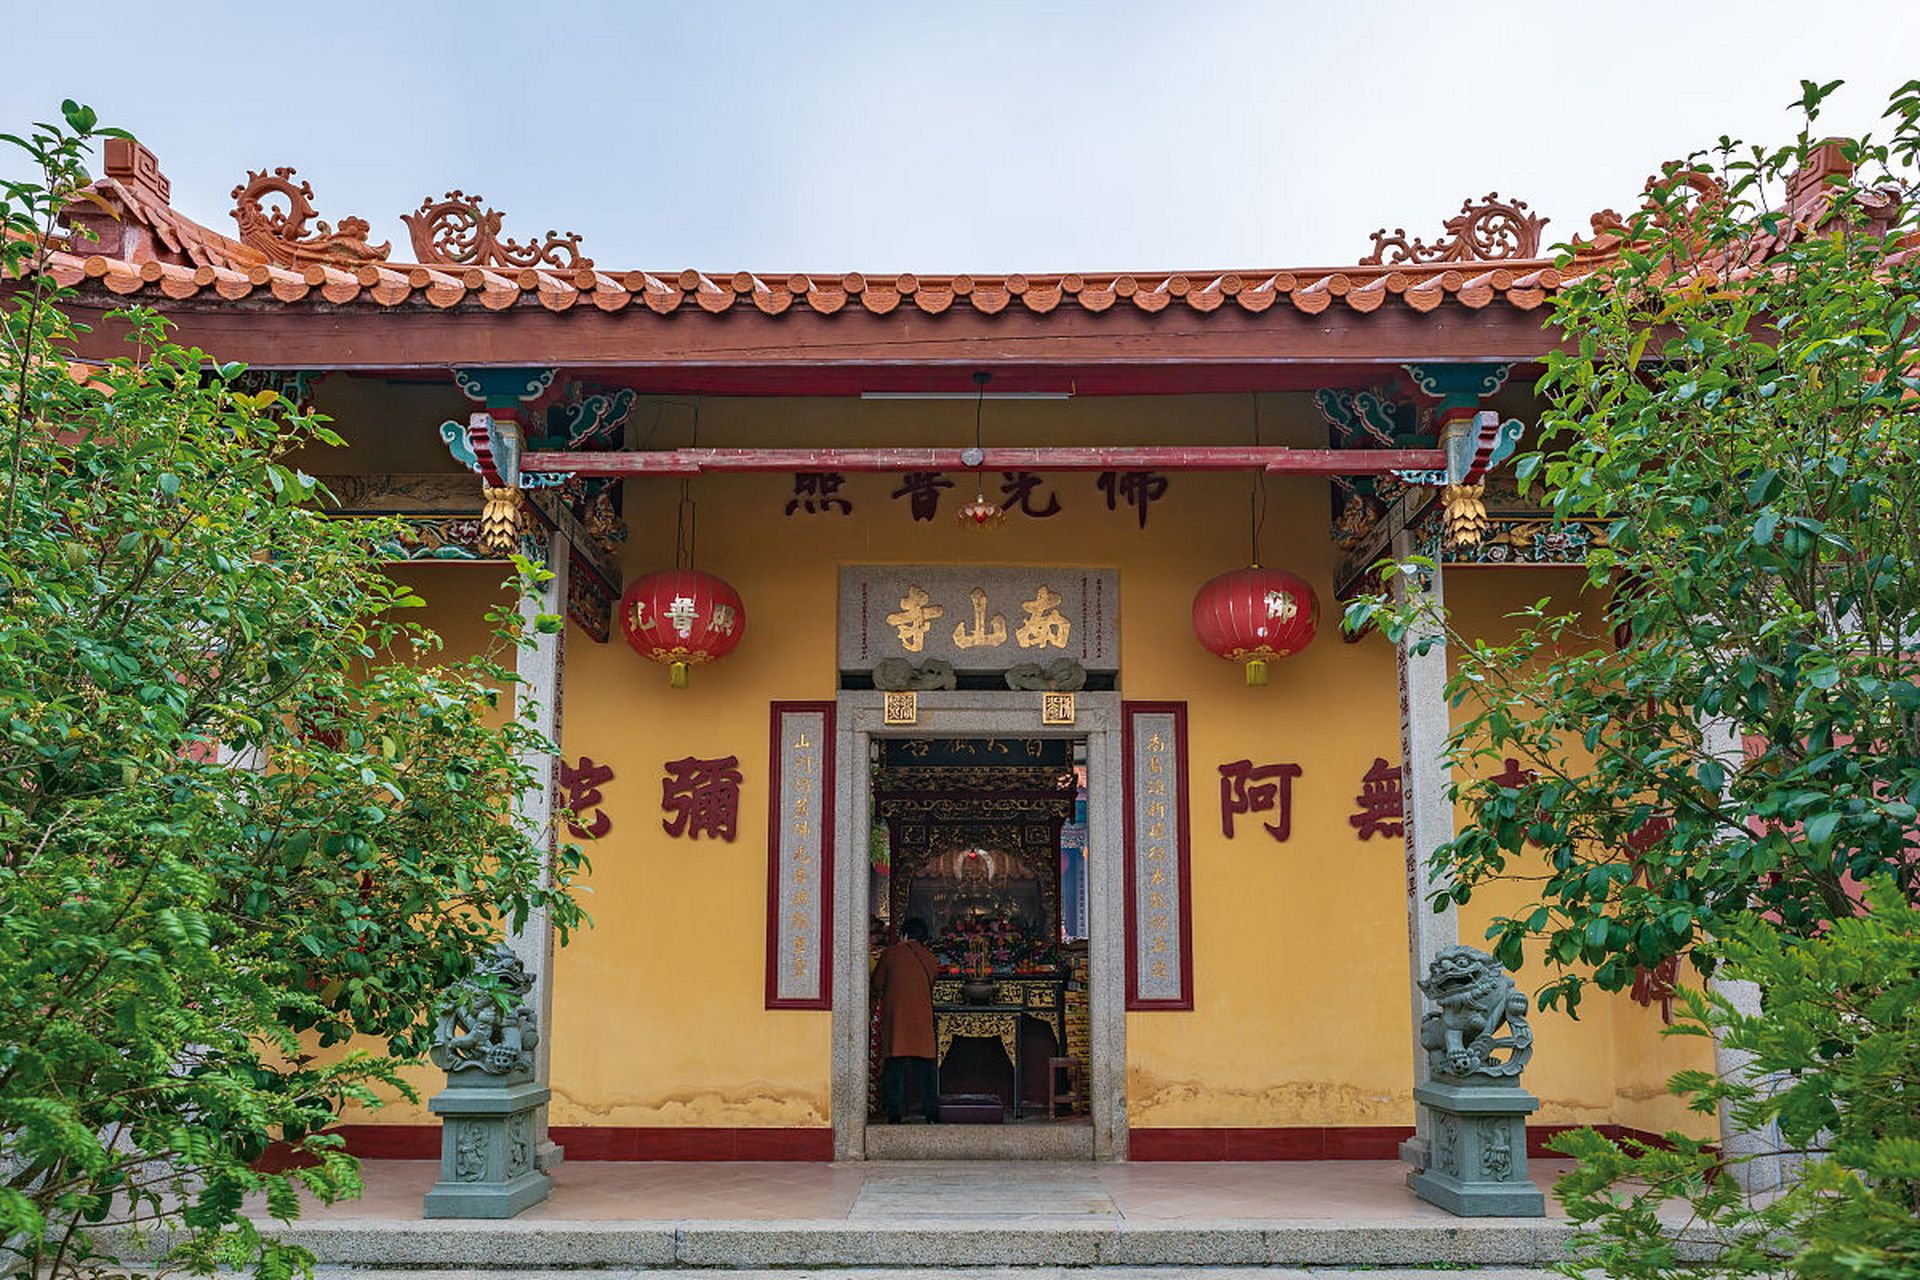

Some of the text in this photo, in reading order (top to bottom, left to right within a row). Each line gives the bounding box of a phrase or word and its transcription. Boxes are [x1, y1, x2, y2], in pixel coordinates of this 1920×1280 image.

[785, 471, 1168, 529] 佛光普照
[886, 584, 1071, 652] 南山寺
